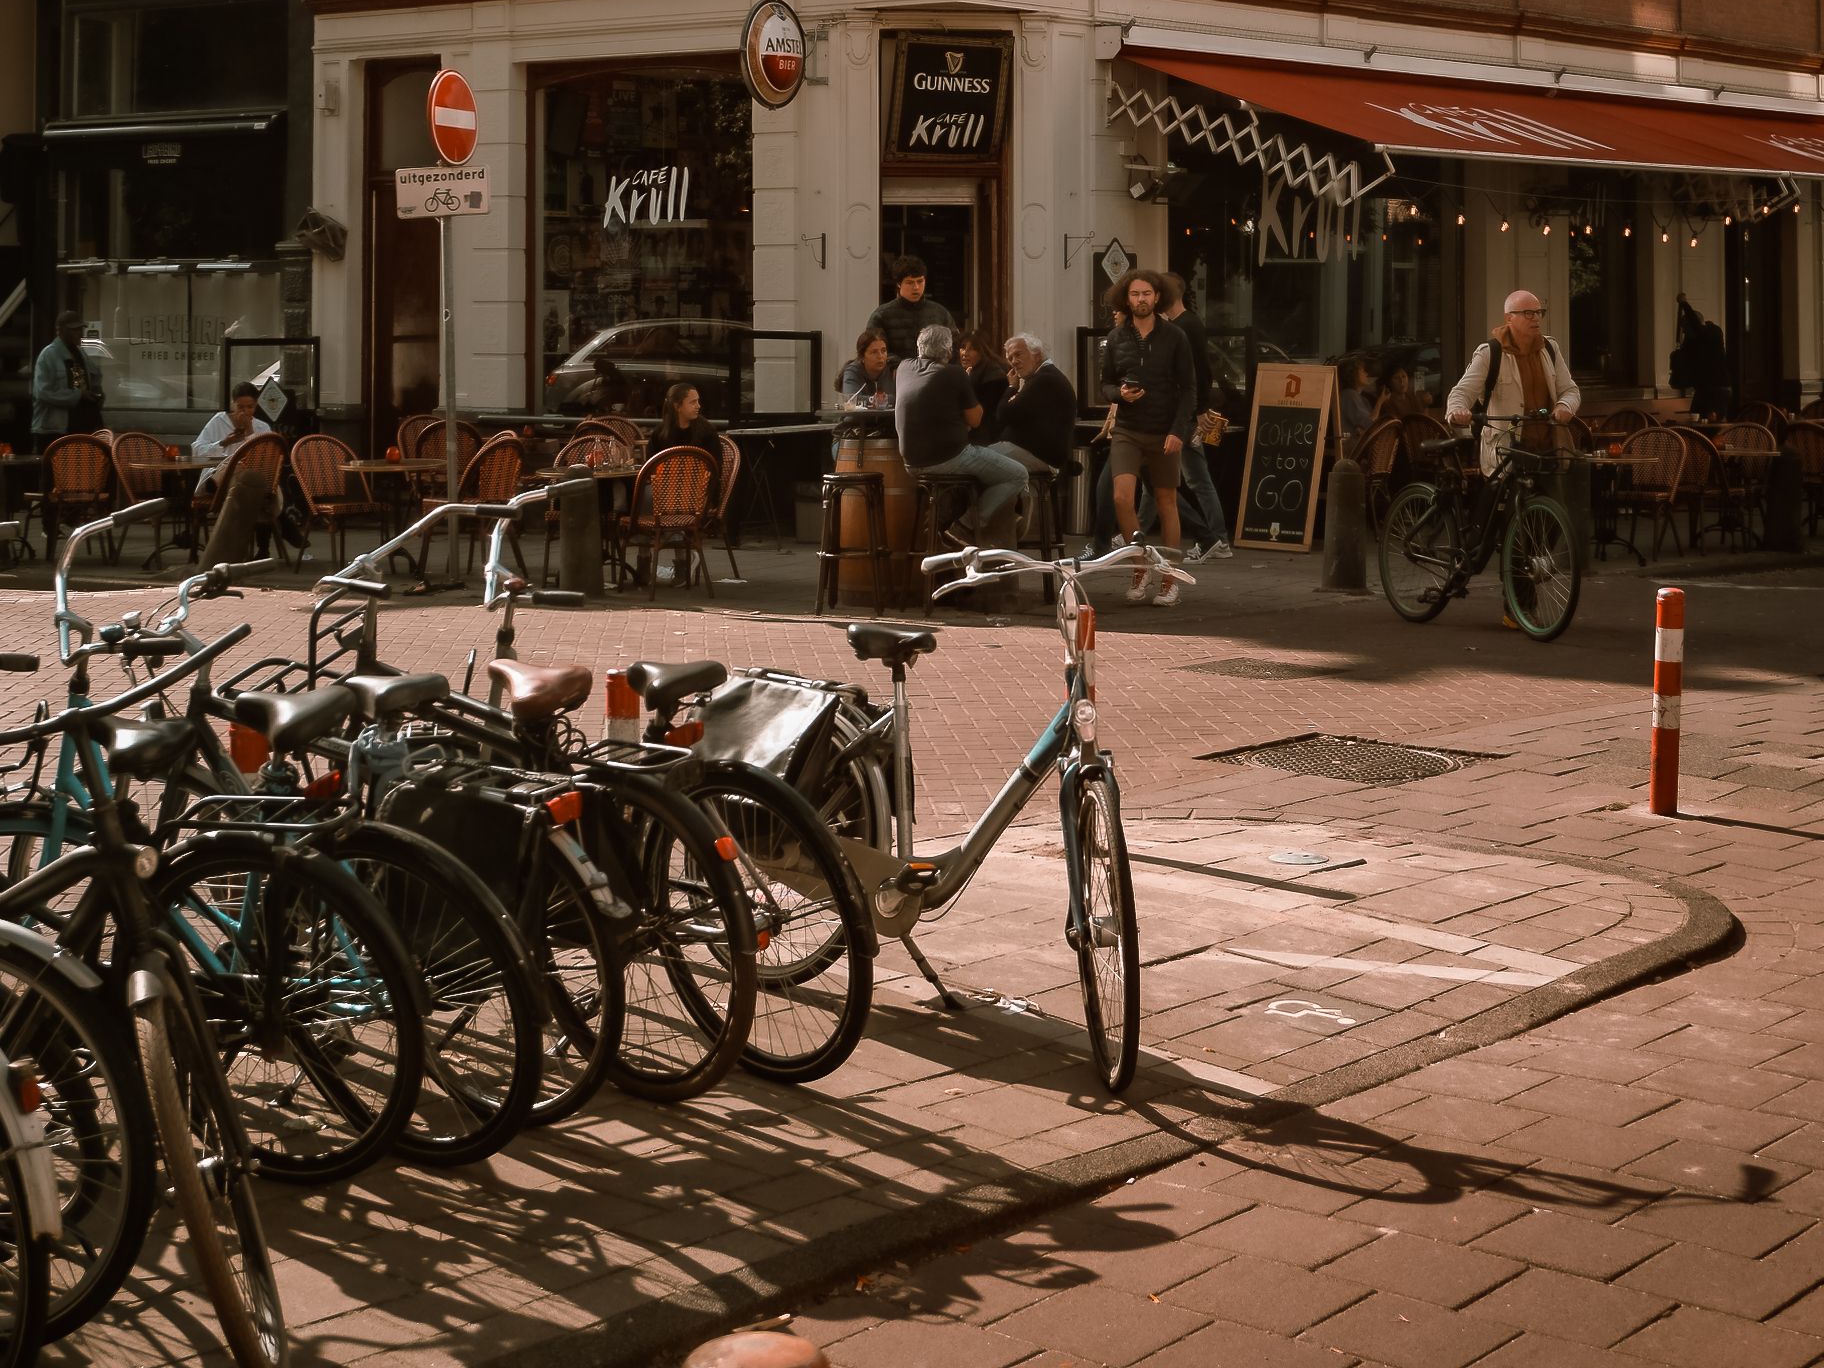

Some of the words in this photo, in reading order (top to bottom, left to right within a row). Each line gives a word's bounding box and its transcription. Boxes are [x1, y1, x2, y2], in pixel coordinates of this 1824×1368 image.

[778, 59, 796, 71] BIER
[913, 72, 991, 94] GUINNESS
[937, 112, 968, 124] CAFÉ
[909, 113, 985, 149] Krull
[400, 168, 485, 186] uitgezonderd
[632, 165, 669, 186] CAFÉ
[603, 166, 689, 228] Krull
[141, 351, 168, 360] FRIED
[174, 351, 215, 361] CHCKEN
[1275, 455, 1296, 470] to
[1255, 474, 1304, 511] GO
